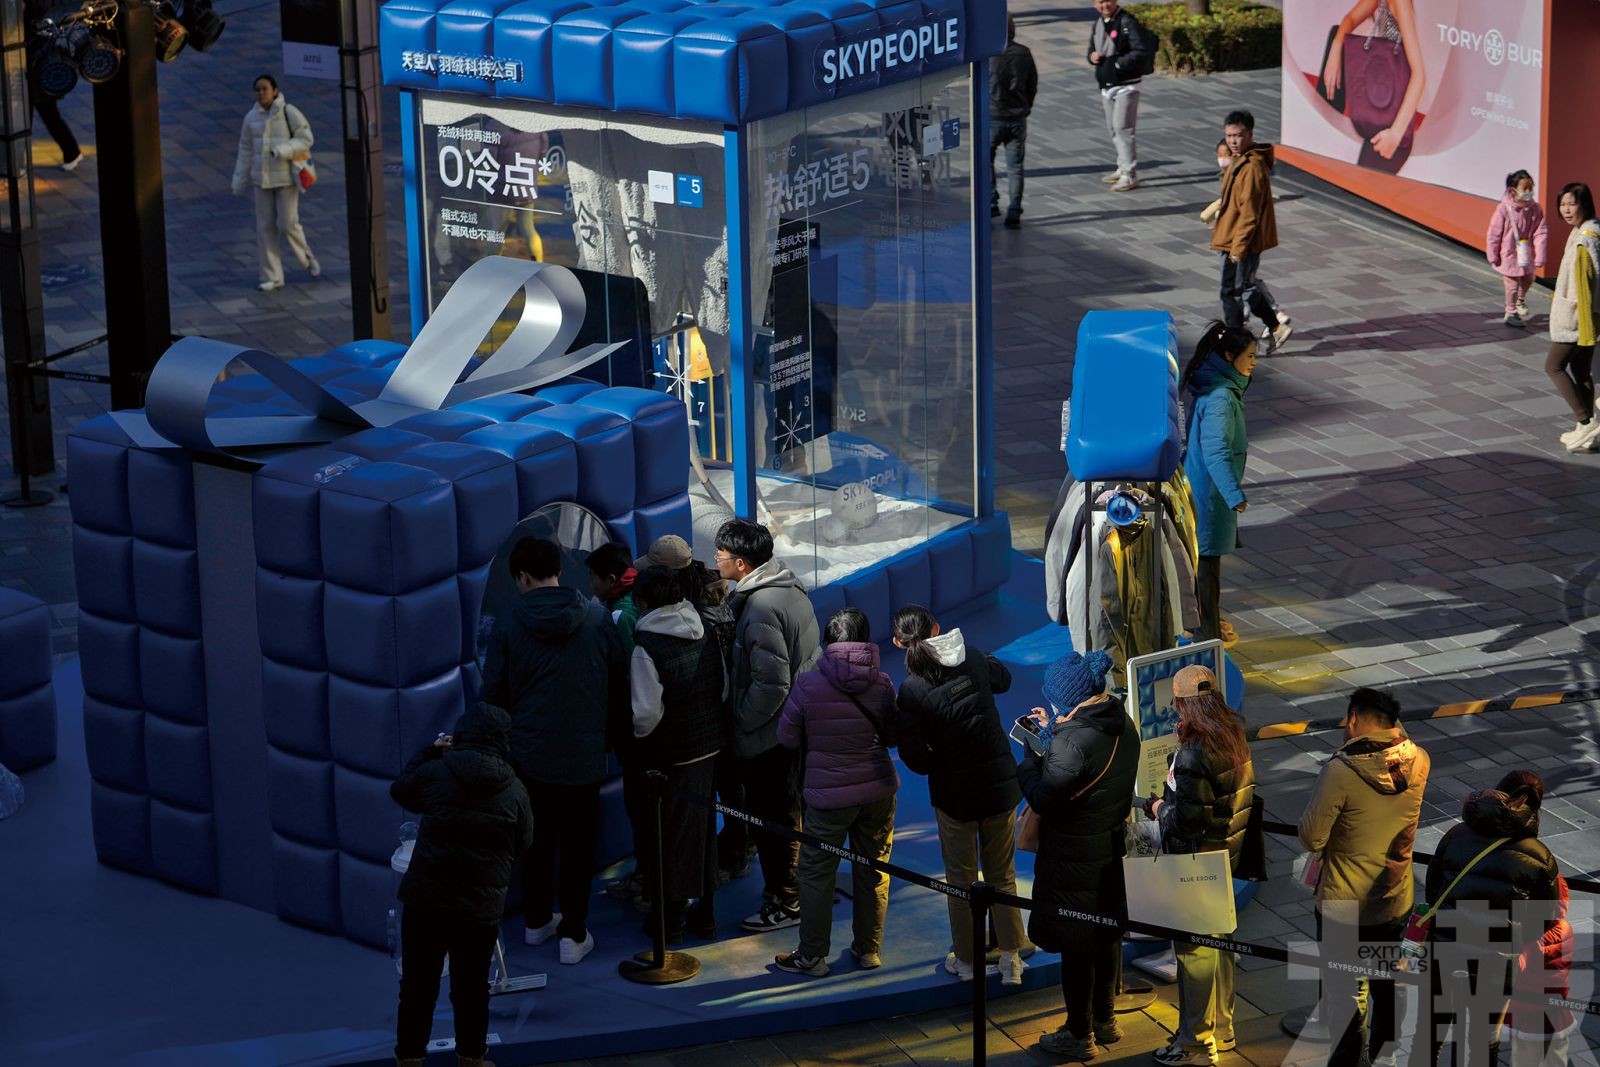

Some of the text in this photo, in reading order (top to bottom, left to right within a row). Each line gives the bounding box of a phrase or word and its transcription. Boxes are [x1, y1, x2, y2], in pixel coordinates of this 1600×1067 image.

[1437, 24, 1482, 51] TORY
[823, 18, 957, 84] SKYPEOPLE
[439, 56, 517, 80] 羽绒科技公司
[437, 126, 501, 145] 充绒科技再进阶
[952, 121, 958, 136] 5
[691, 179, 701, 194] 5
[764, 148, 870, 219] 热舒适5
[441, 208, 478, 225] 箱式充绒
[442, 224, 505, 244] 不漏风也不漏绒
[655, 344, 661, 355] 1
[698, 401, 705, 413] 7
[804, 395, 810, 407] 3
[715, 803, 749, 822] SKYPEOPLE
[820, 842, 855, 861] SKYPEOPLE
[930, 880, 966, 899] SKYPEOPLE
[1058, 908, 1100, 923] SKYPEOPLE
[1191, 935, 1234, 951] SKYPEOPLE
[1328, 961, 1373, 976] SKYPEOPLE
[1548, 998, 1597, 1013] SKYPEOPLE
